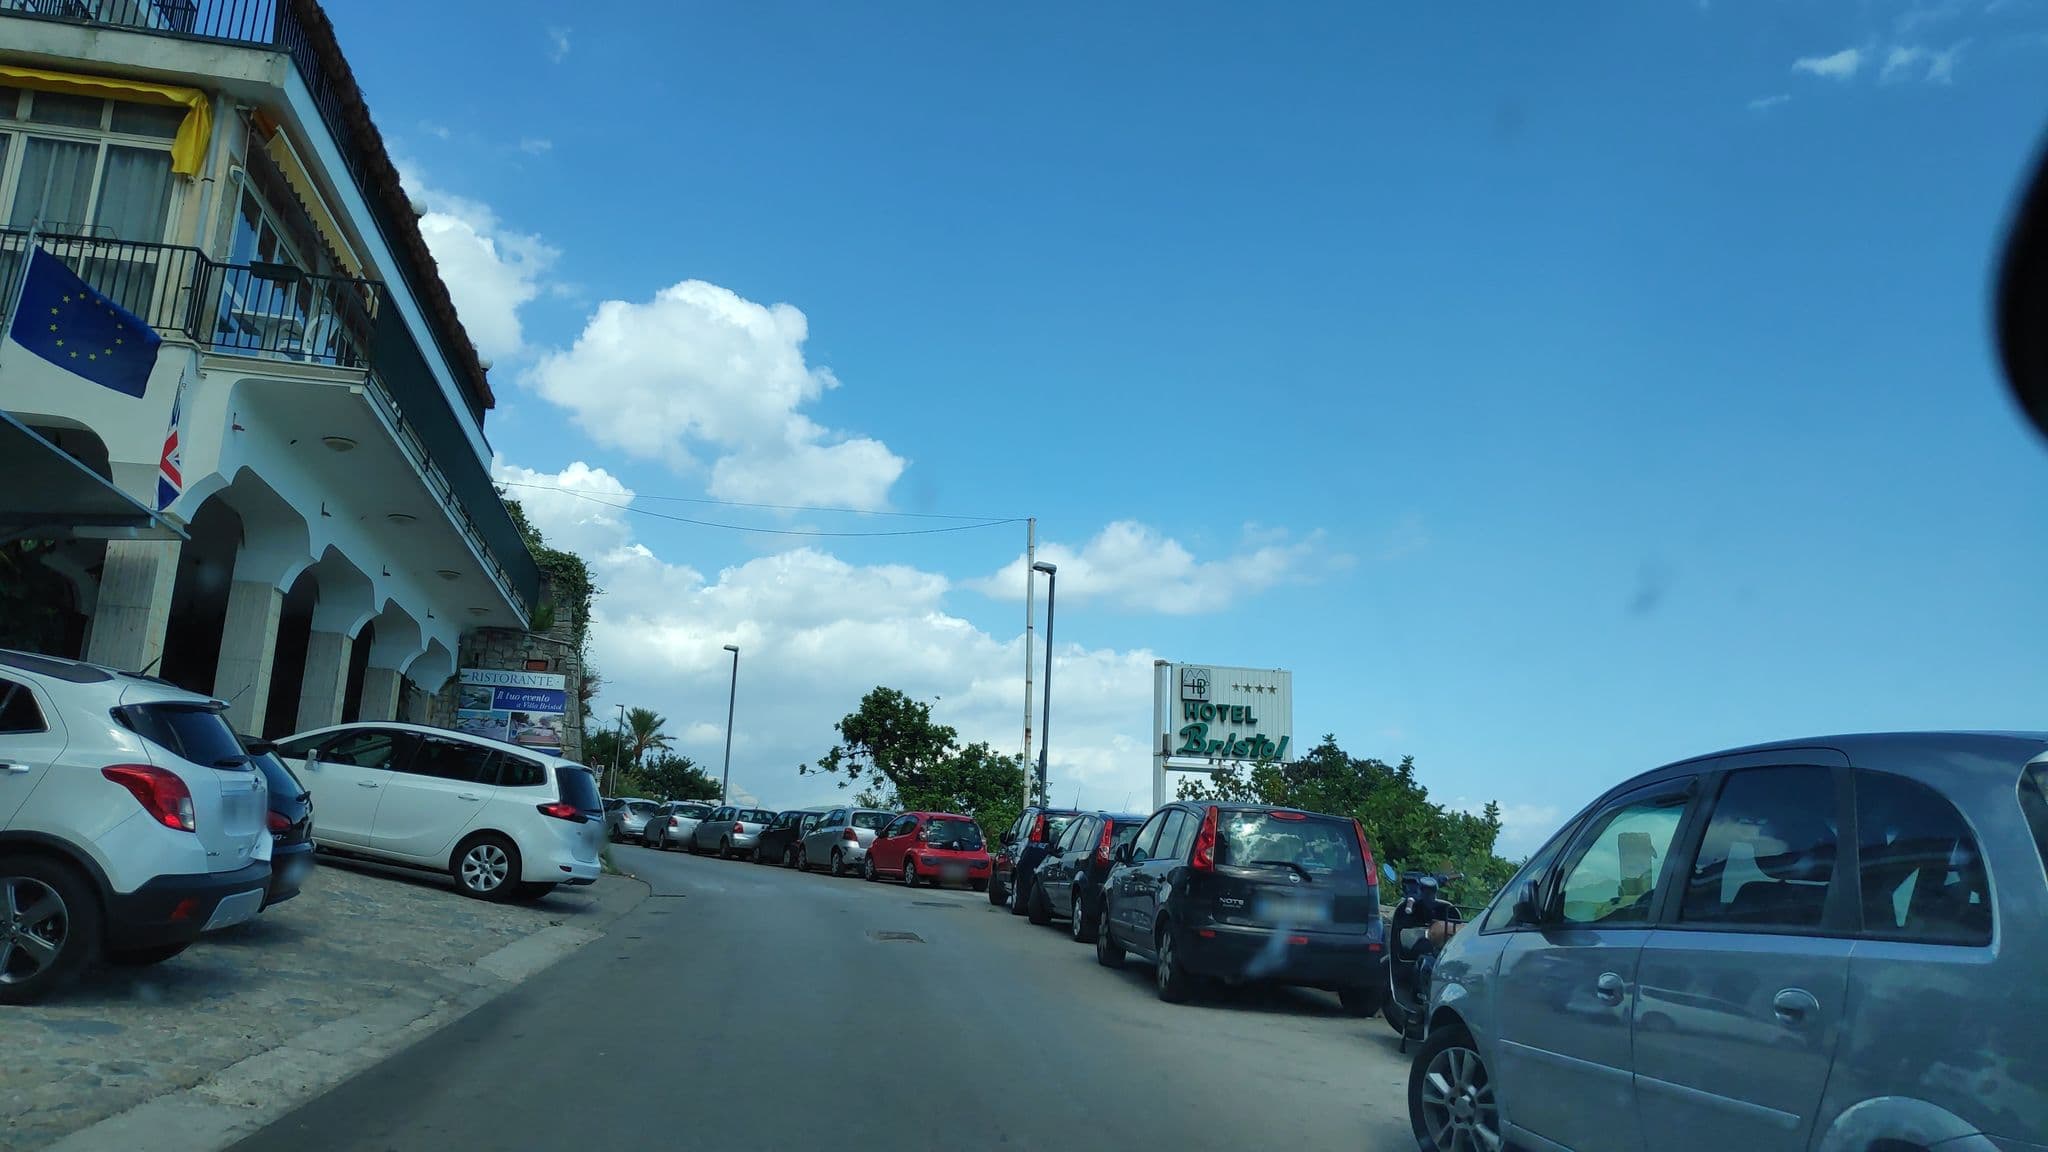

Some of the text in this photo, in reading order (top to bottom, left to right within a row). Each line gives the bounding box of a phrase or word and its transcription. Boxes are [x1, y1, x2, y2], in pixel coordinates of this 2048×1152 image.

[471, 672, 552, 687] RISTORANTE
[496, 690, 549, 702] Il tuo evento
[539, 703, 562, 711] Bristol
[1184, 702, 1258, 724] HOTEL
[1176, 722, 1290, 760] Bristol
[1219, 897, 1244, 905] NOTE
